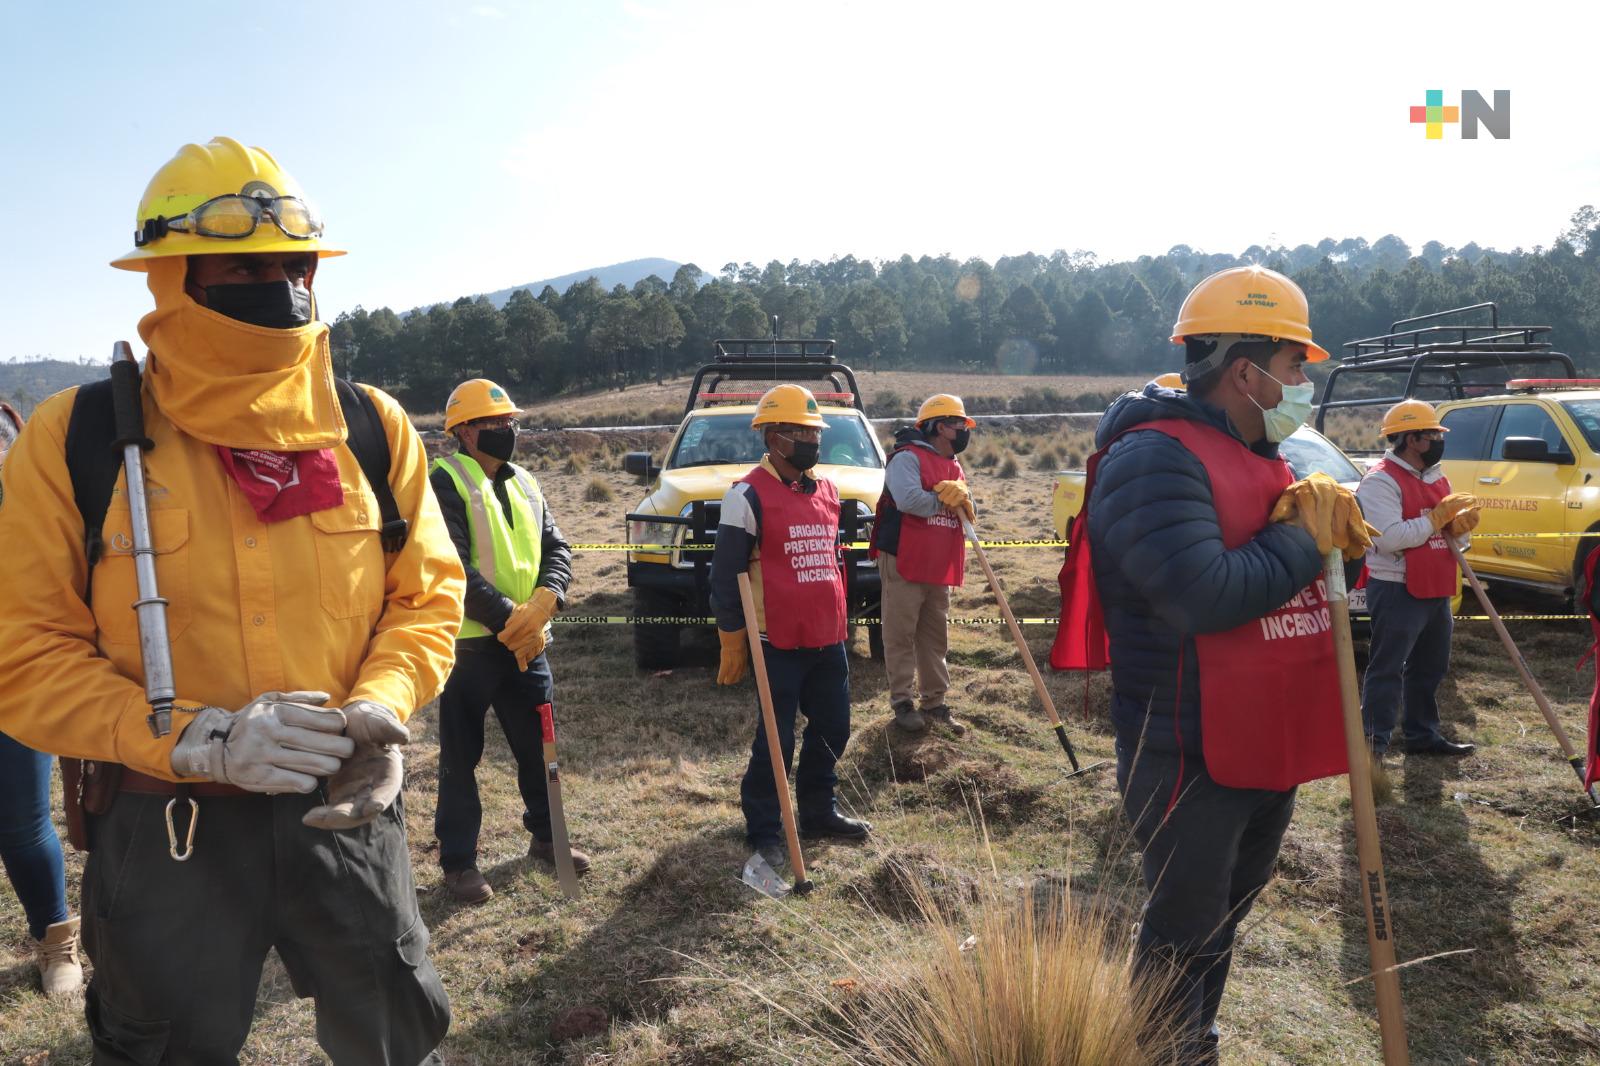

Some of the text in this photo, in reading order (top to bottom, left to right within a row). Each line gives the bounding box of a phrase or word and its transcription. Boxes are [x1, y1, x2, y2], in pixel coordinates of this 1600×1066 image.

[788, 524, 827, 539] BRIGADA
[783, 538, 835, 554] PREVENCIO
[625, 616, 708, 624] PRECAUCION
[1366, 869, 1388, 941] SURTEK
